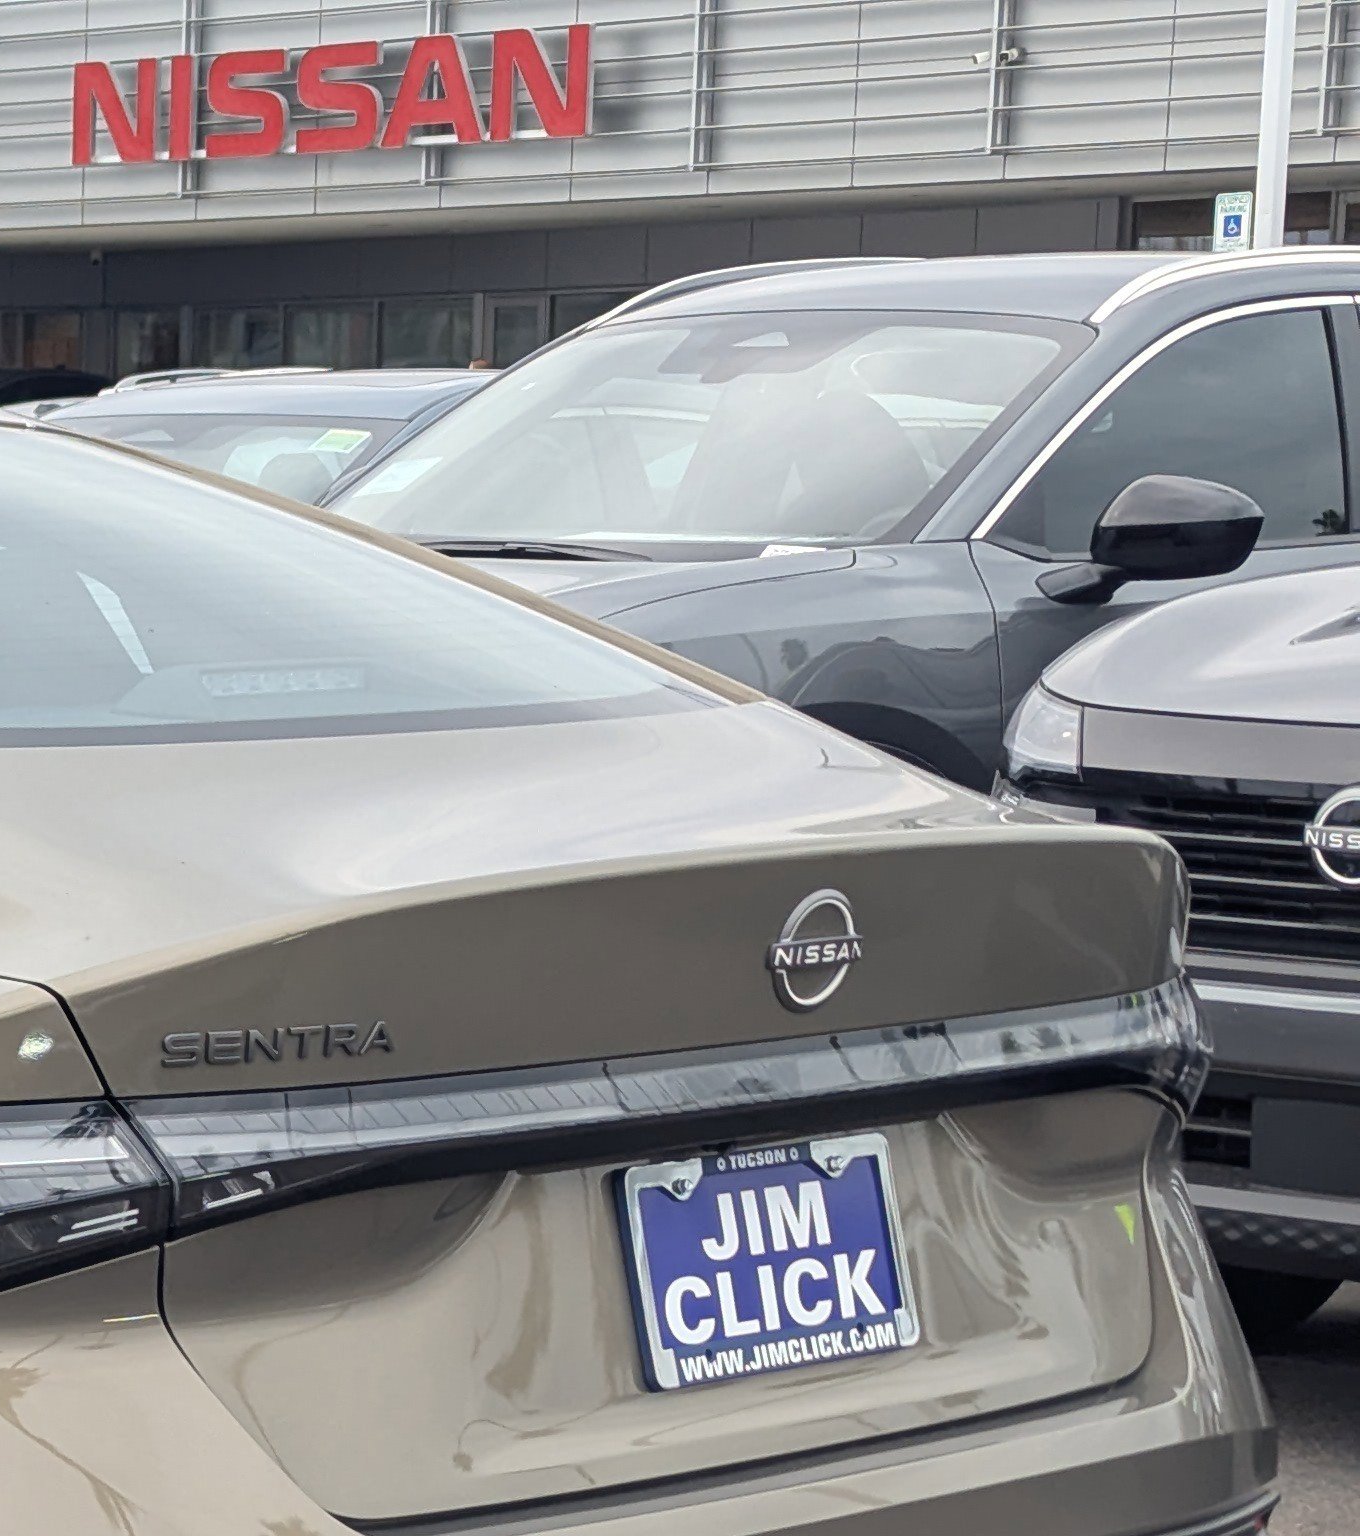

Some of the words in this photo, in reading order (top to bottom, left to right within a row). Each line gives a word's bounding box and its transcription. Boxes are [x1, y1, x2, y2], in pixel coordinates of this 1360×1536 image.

[72, 23, 592, 166] NISSAN
[773, 940, 862, 968] NISSAN
[161, 1020, 395, 1068] SENTRA
[729, 1149, 787, 1170] TUCSON
[701, 1180, 831, 1261] JIM
[665, 1248, 886, 1345] CLICK
[680, 1322, 896, 1383] WWW.JIMCLICK.COM
